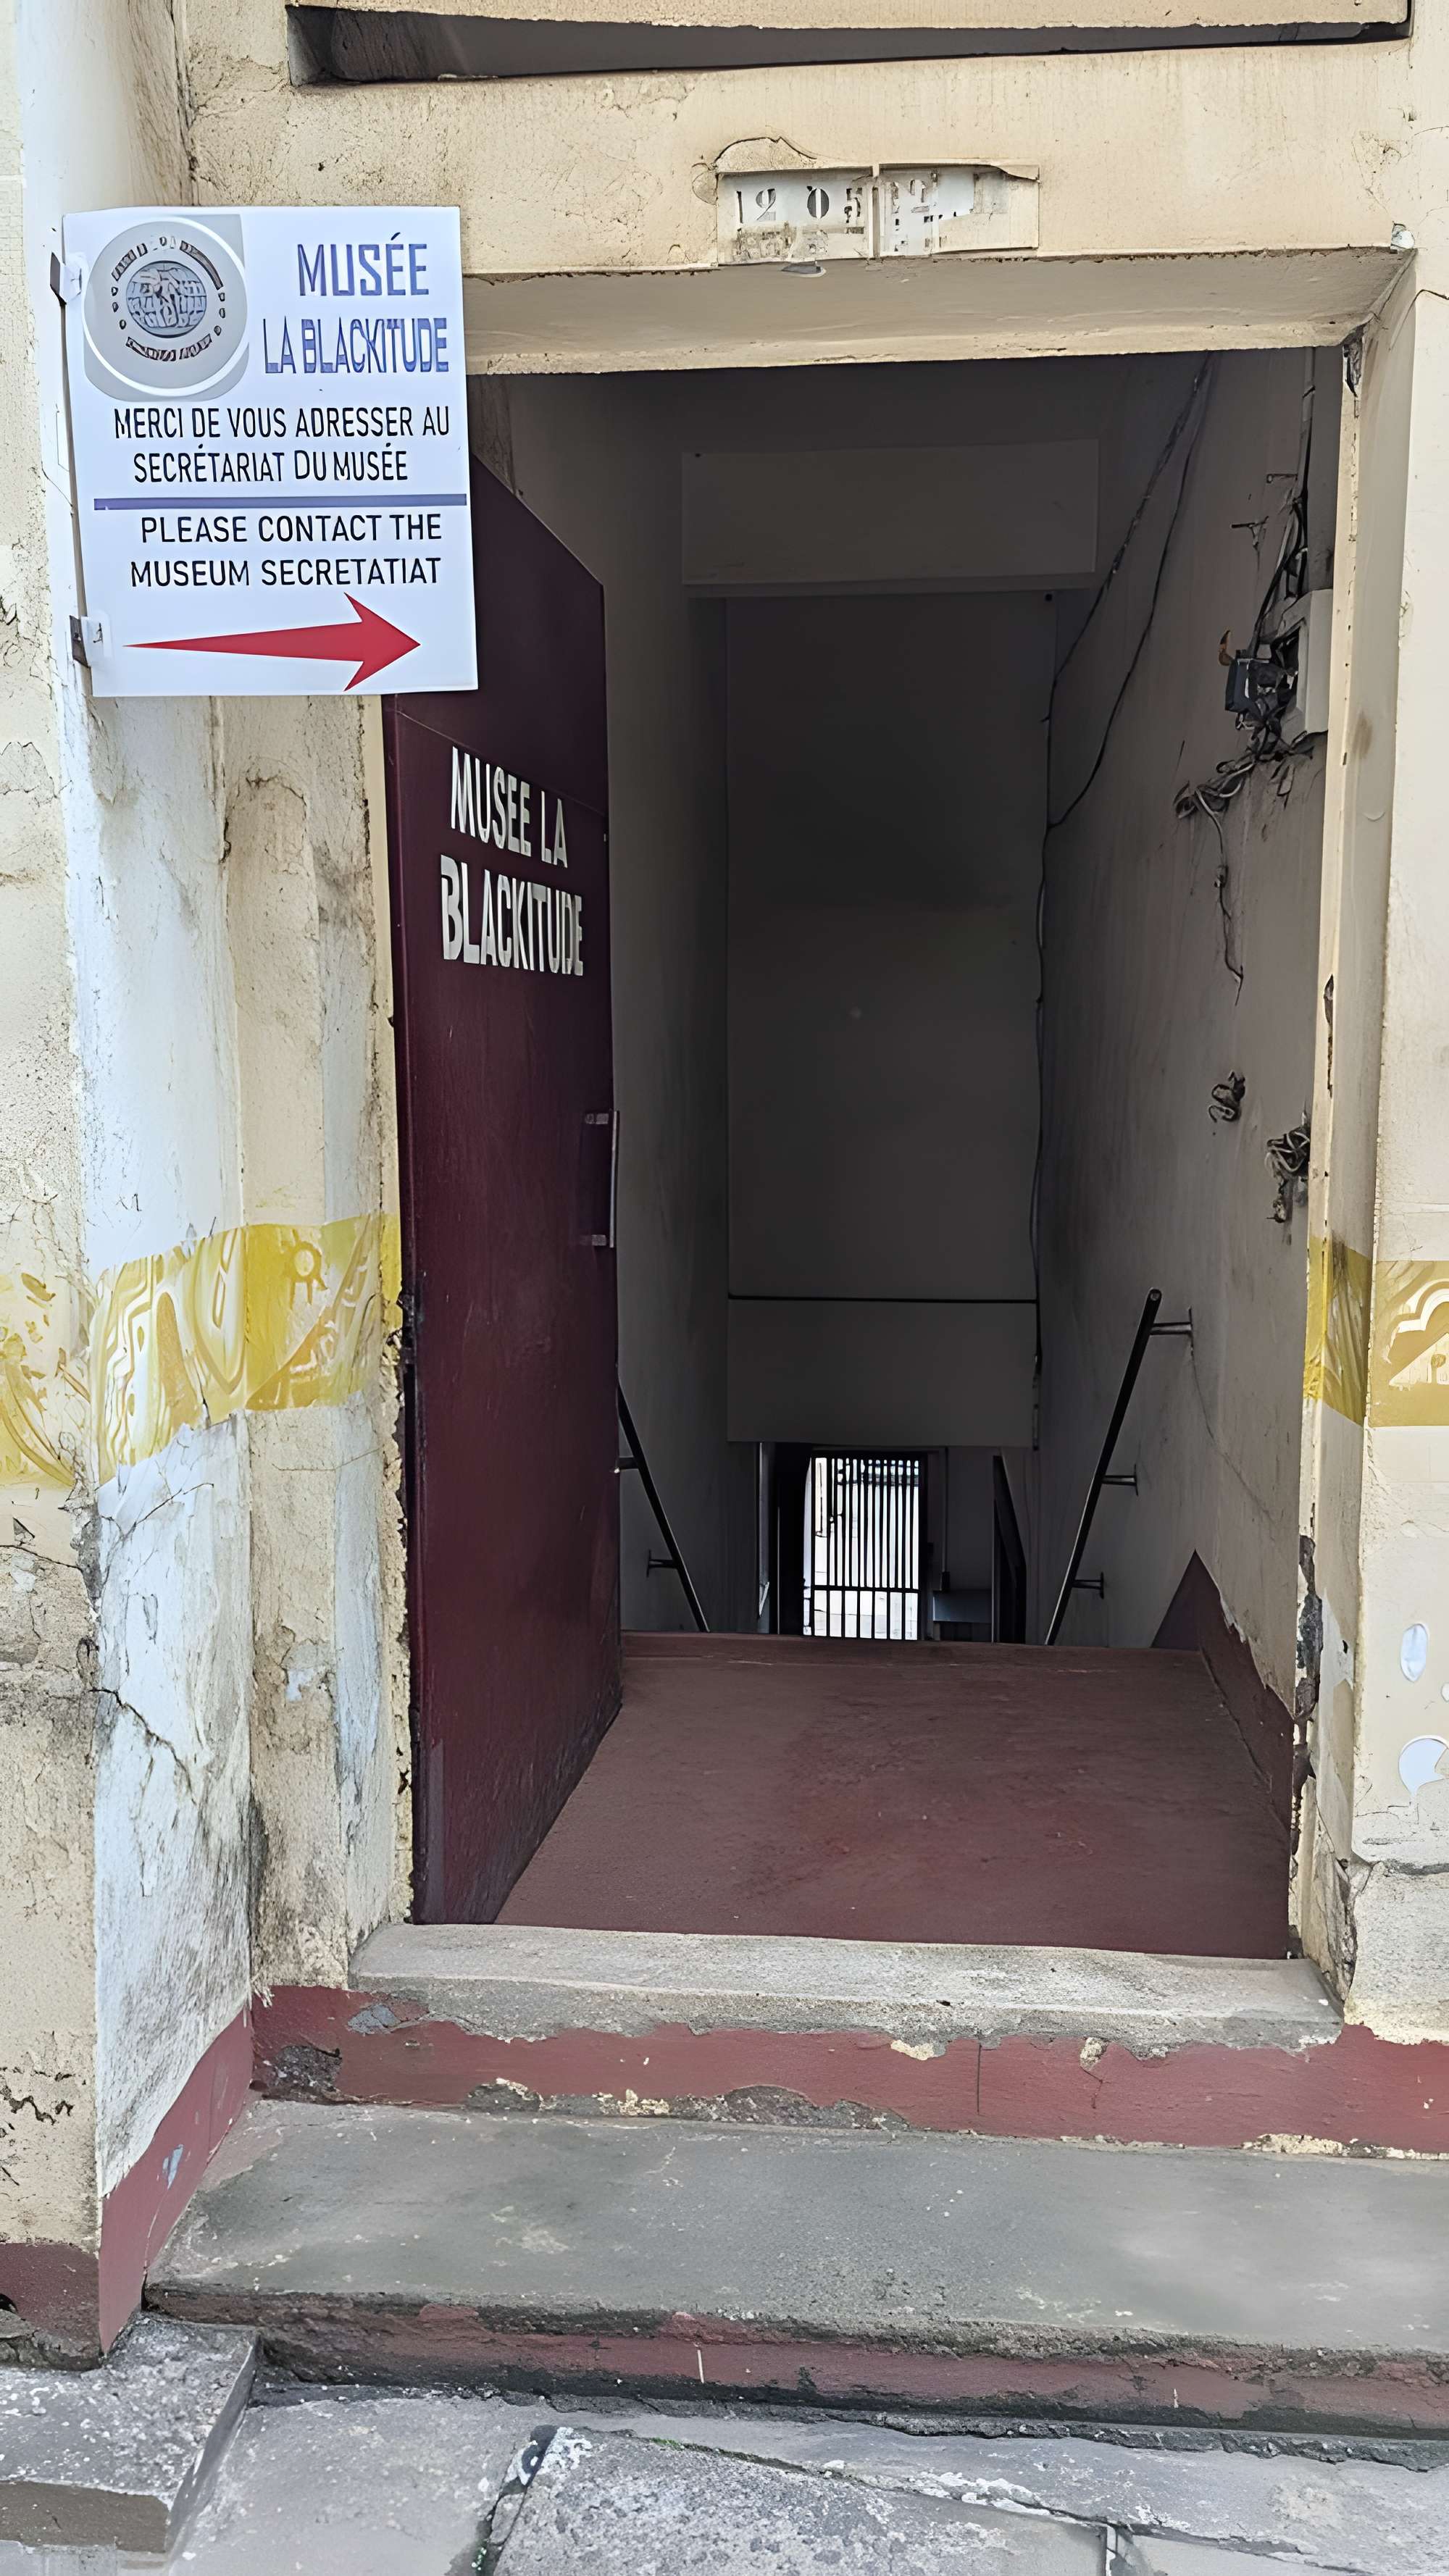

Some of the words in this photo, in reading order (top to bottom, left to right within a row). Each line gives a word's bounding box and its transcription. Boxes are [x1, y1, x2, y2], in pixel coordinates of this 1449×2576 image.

[297, 232, 429, 296] MUSÉE
[263, 316, 296, 374] LA
[301, 317, 449, 374] BLACKITUDE
[114, 408, 183, 438] MERCI
[192, 408, 220, 438] DE
[227, 408, 287, 438] VOUS
[296, 407, 413, 437] ADRESSER
[422, 406, 449, 435] AU
[134, 444, 285, 482] SECRÉTARIAT
[294, 450, 326, 481] DU
[333, 443, 407, 480] MUSÉE
[142, 516, 247, 543] PLEASE
[259, 515, 382, 542] CONTACT
[391, 514, 442, 540] THE
[131, 561, 249, 587] MUSEUM
[262, 558, 440, 585] SECRETATIAT
[451, 746, 531, 857] MUSEE
[541, 791, 568, 868] LA
[440, 854, 583, 976] BLACKITUDE
